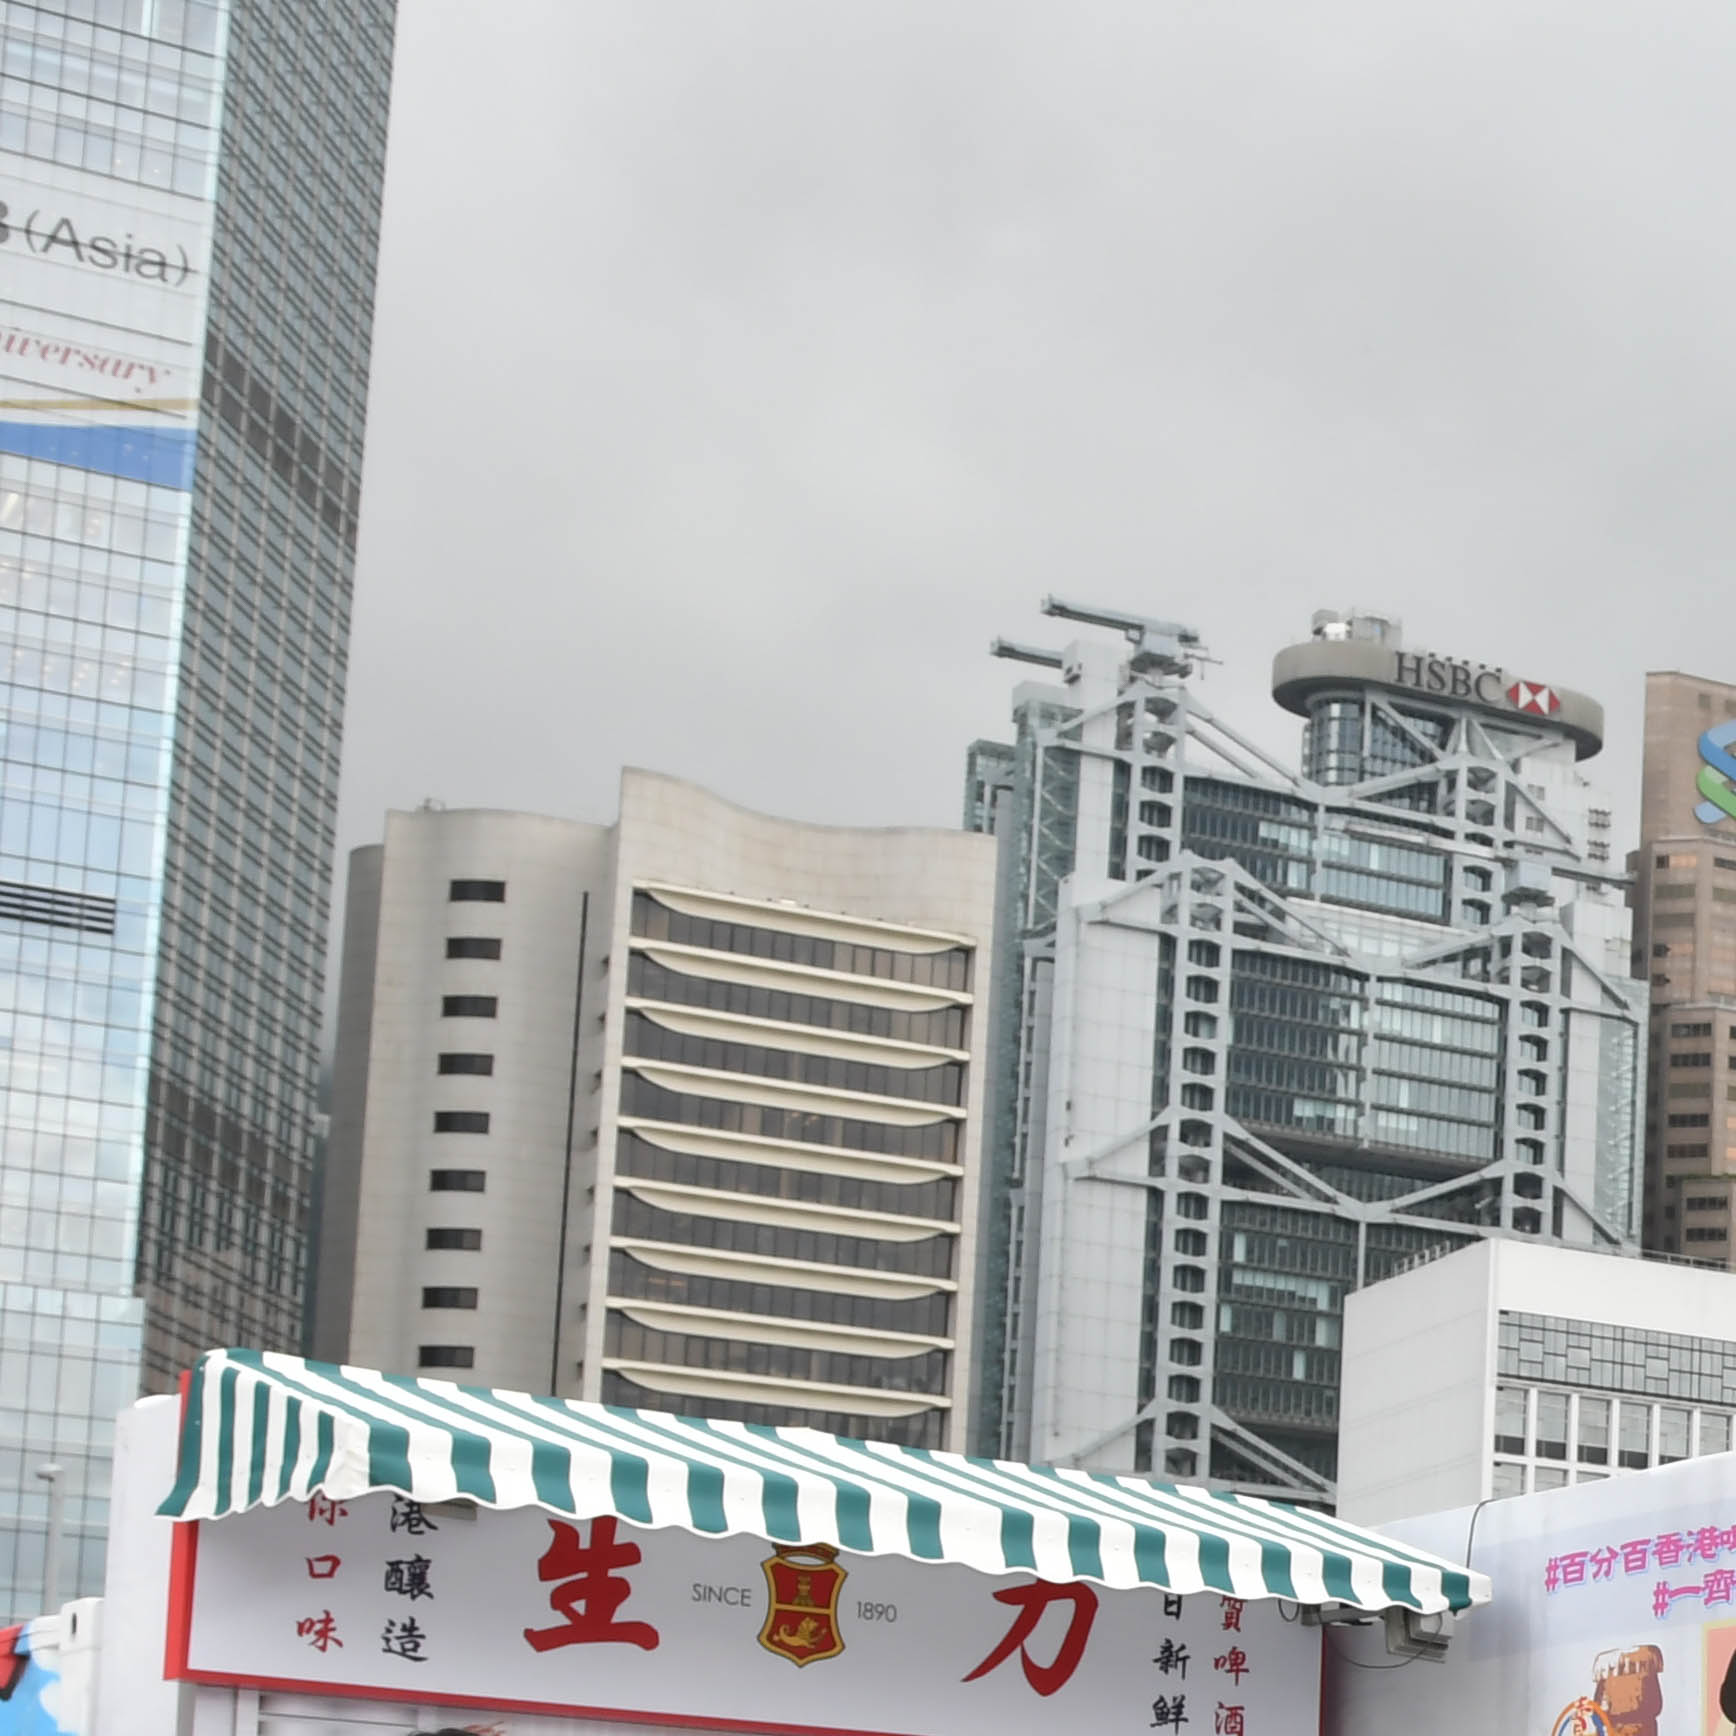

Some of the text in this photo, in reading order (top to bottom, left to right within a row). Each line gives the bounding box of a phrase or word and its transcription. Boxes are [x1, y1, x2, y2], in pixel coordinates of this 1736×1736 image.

[0, 330, 171, 393] iversary
[1394, 650, 1502, 707] HSBC
[381, 1494, 438, 1662] 港釀造
[691, 1583, 898, 1623] SINCE 1890
